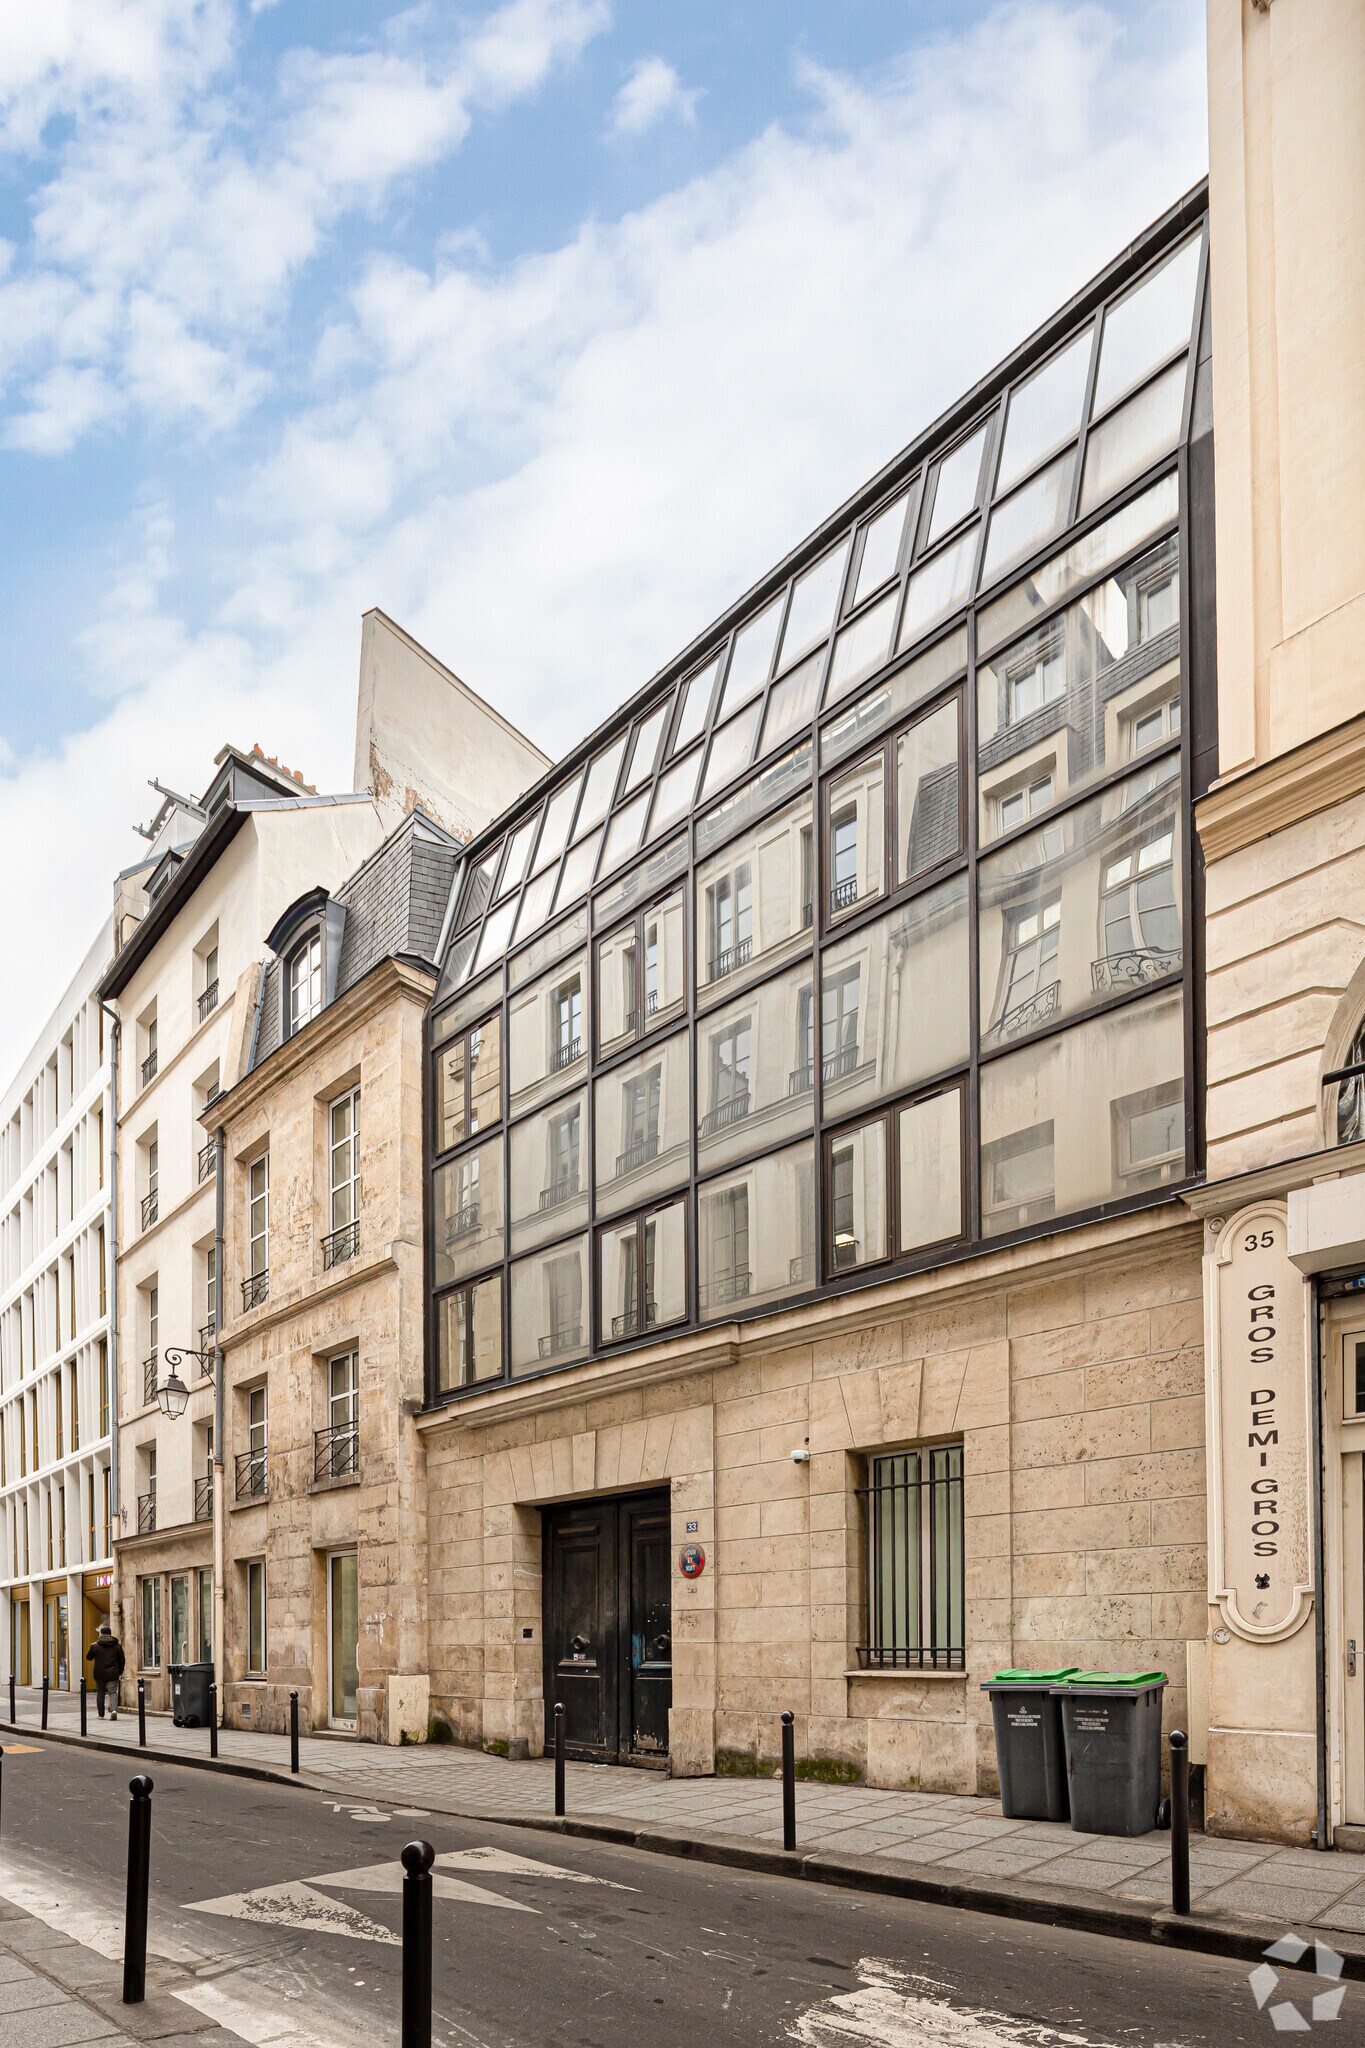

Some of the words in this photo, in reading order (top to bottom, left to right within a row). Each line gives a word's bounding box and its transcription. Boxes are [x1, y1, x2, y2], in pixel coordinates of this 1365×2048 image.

[1244, 1229, 1274, 1252] 35
[1248, 1284, 1276, 1364] GROS
[1248, 1389, 1278, 1467] DEMI
[687, 1522, 697, 1531] 33
[1250, 1478, 1279, 1557] GROS
